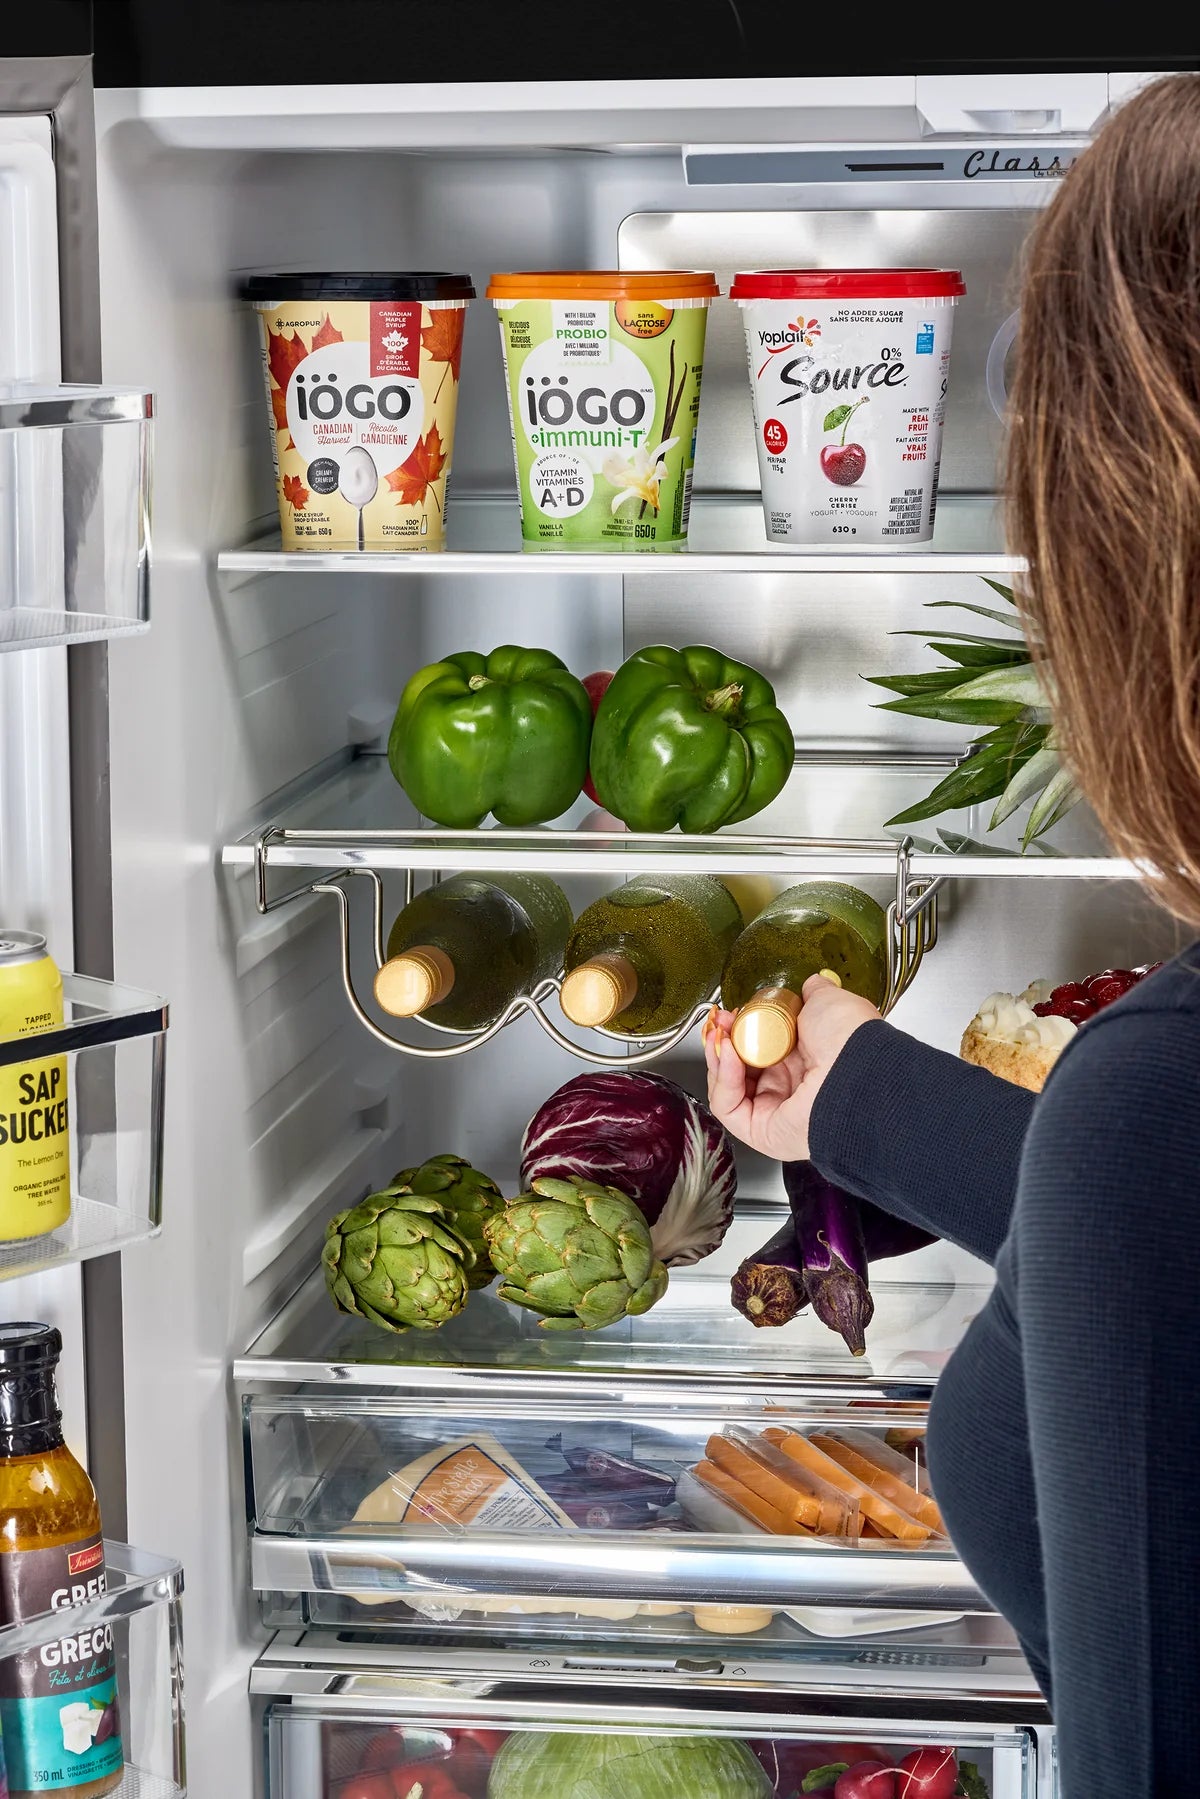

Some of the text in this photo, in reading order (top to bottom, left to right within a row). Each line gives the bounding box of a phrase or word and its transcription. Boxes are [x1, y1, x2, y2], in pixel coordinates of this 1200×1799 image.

[964, 150, 1077, 178] Class
[624, 319, 665, 328] LACTOSE
[556, 329, 607, 340] PROBIO
[881, 347, 902, 361] 0%
[777, 355, 909, 406] Source
[911, 414, 929, 423] REAL
[313, 423, 353, 436] CANADIAN
[369, 422, 398, 433] Récolte
[767, 425, 781, 440] 45
[908, 423, 929, 432] FRUIT
[318, 435, 350, 445] Harvest
[361, 433, 408, 446] CANADIENNE
[906, 444, 927, 452] VRAIS
[537, 454, 557, 466] SOURCE
[902, 452, 926, 461] FRUITS
[540, 468, 577, 477] VITAMIN
[536, 477, 584, 486] VITAMINES
[318, 528, 328, 536] 650
[25, 1013, 52, 1024] TAPPED
[19, 1067, 60, 1105] SAP
[33, 1155, 54, 1166] Lemon
[13, 1182, 42, 1192] ORGANIC
[27, 1186, 60, 1199] TREE WATER
[442, 1459, 479, 1489] Stelle
[448, 1478, 483, 1511] ASIAGO
[48, 1669, 71, 1688] Feta
[75, 1666, 84, 1681] et
[67, 1761, 95, 1773] DRESSING
[67, 1764, 104, 1778] VINAIGRETTE
[33, 1769, 64, 1782] 350 mL
